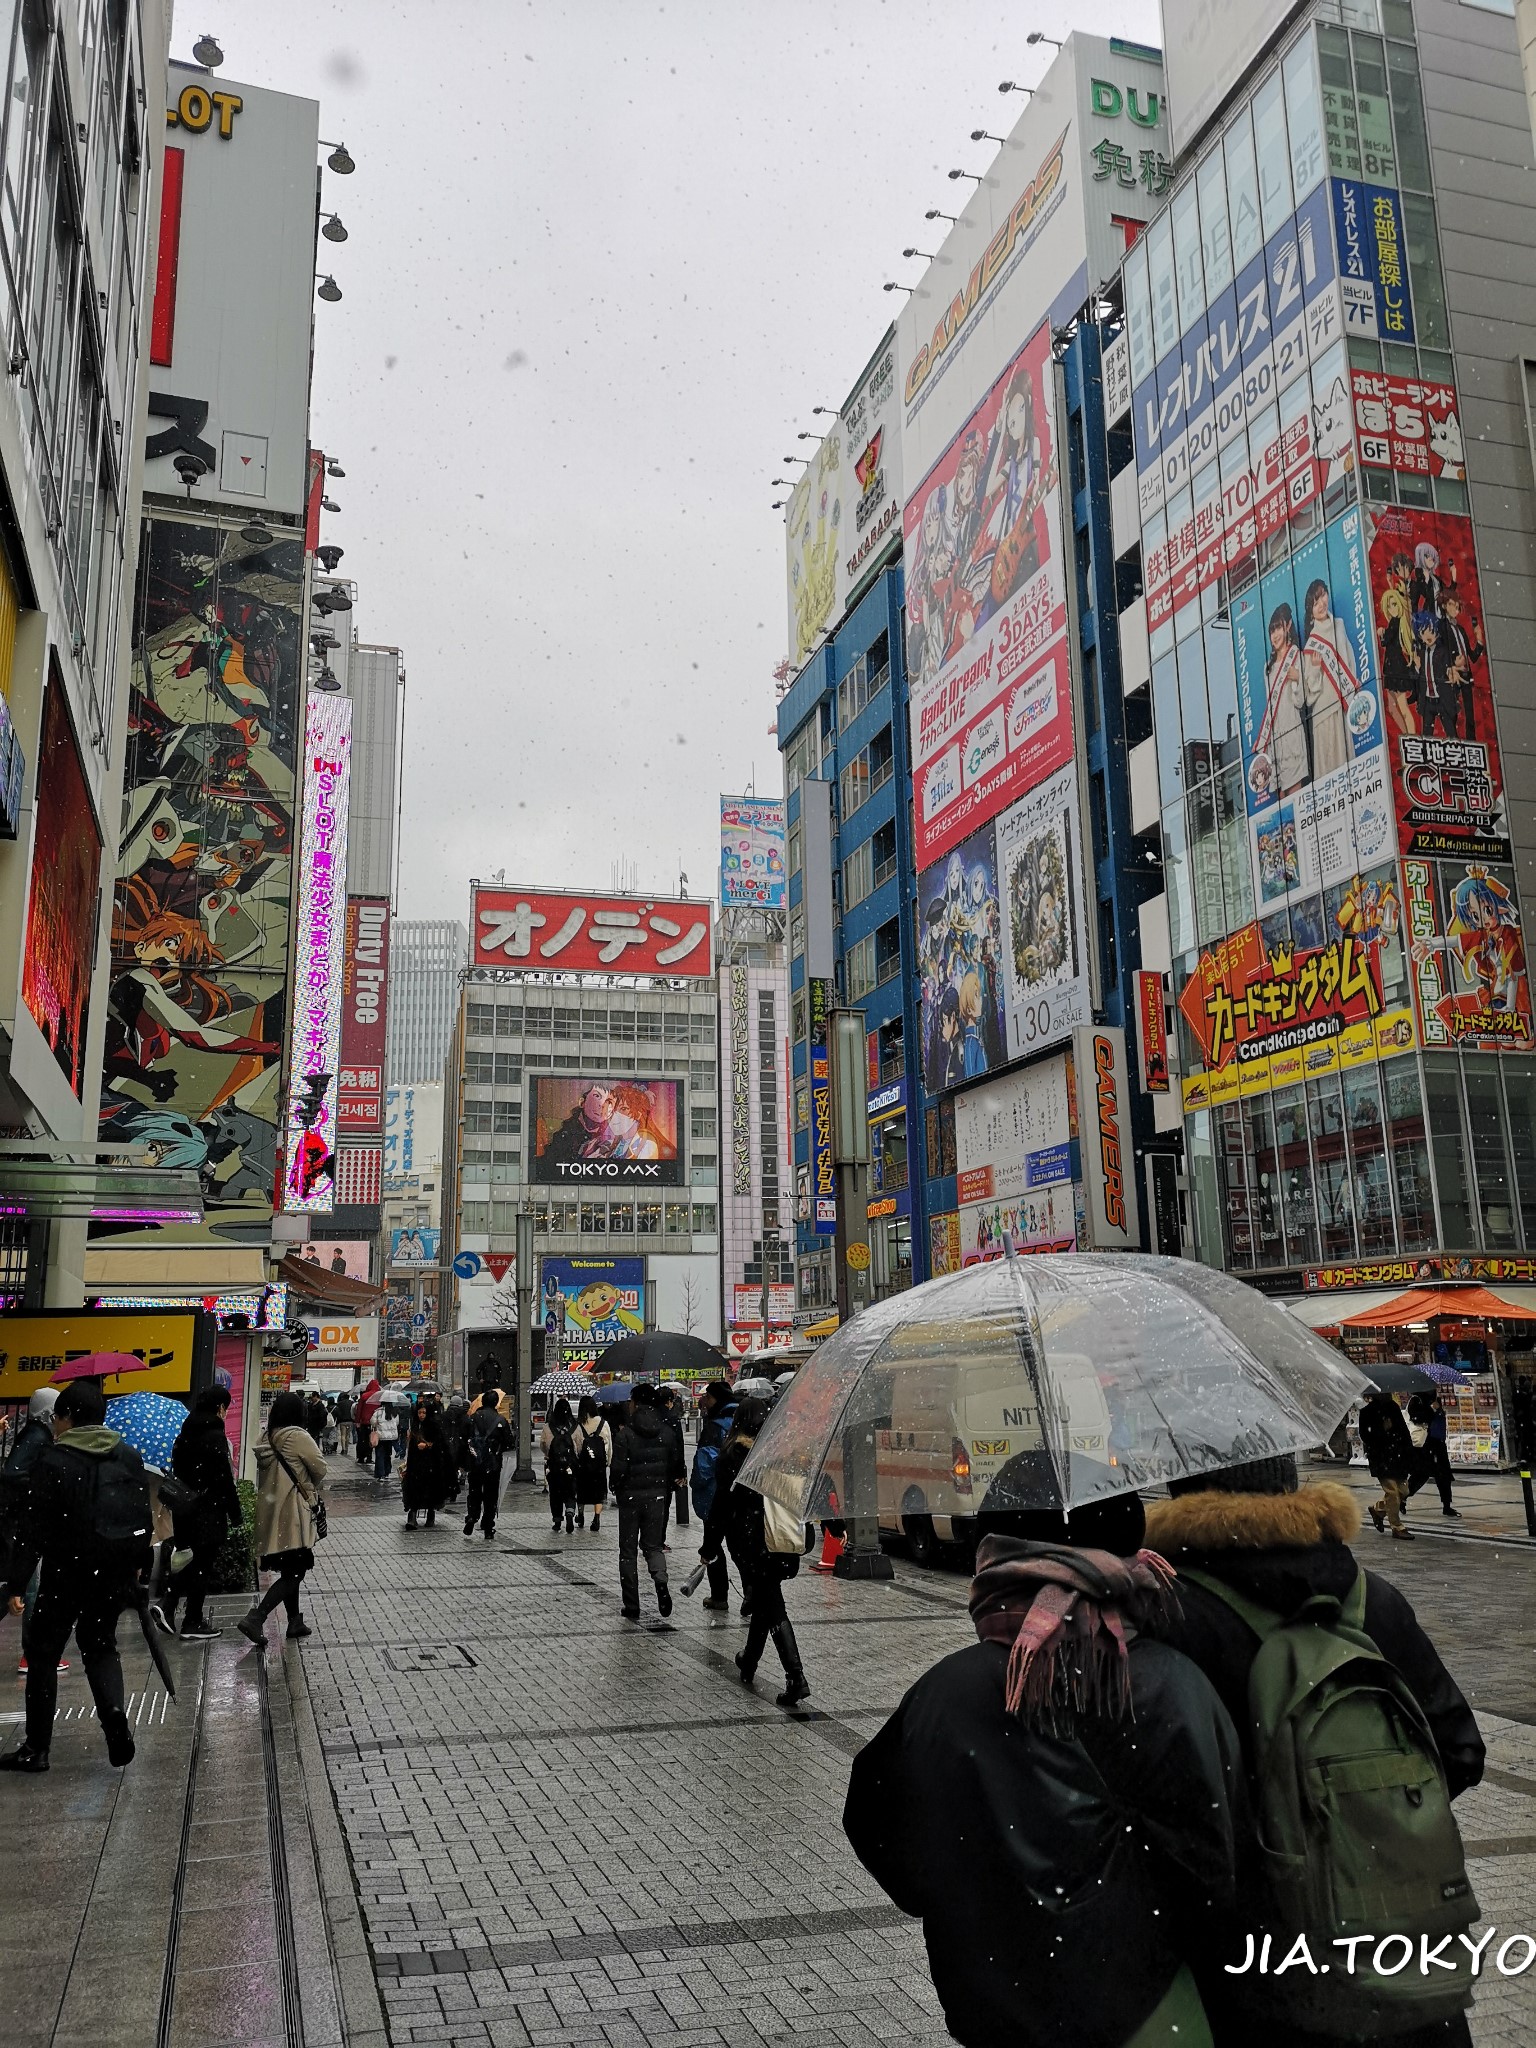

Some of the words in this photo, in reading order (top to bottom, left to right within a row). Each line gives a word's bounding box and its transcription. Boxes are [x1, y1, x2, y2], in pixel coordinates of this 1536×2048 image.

[1090, 77, 1167, 128] DU
[1323, 90, 1372, 115] 不動産
[1365, 154, 1395, 178] 8F
[904, 118, 1072, 402] GAMERS
[1372, 194, 1407, 332] お部屋探しは
[1342, 285, 1373, 301] 当ビル
[1311, 306, 1336, 346] 7F
[1344, 301, 1375, 326] 7F
[1353, 374, 1454, 409] ホビーランド
[1355, 398, 1426, 440] ぽち
[1363, 440, 1387, 460] 6F
[1393, 440, 1429, 457] 秋葉原
[1394, 454, 1430, 471] 2号店
[1223, 460, 1264, 519] TOY
[1292, 470, 1313, 501] 6F
[1404, 739, 1485, 769] 宮地学園
[1298, 755, 1380, 806] バミューダトライアングル
[1365, 779, 1383, 796] AIR
[1405, 764, 1467, 808] CF
[1466, 783, 1492, 811] 部
[999, 777, 1072, 838] ソードアート・オンライン
[354, 905, 387, 965] Duty
[479, 901, 707, 966] オノデン
[1406, 862, 1448, 1045] カードゲム専門店
[354, 968, 385, 1024] Free
[1205, 934, 1382, 1065] カードキングダム
[1012, 999, 1051, 1047] 1.30
[1053, 1018, 1065, 1031] ON
[1066, 1009, 1083, 1025] SALE
[339, 1069, 378, 1089] 免税
[1093, 1034, 1127, 1237] GAMERS
[555, 1161, 619, 1178] TOKYO
[623, 1163, 662, 1177] MX
[487, 1258, 510, 1268] 止まれ
[571, 1260, 605, 1269] Welcome
[606, 1260, 616, 1269] to
[1334, 1261, 1415, 1285] カードキングダム
